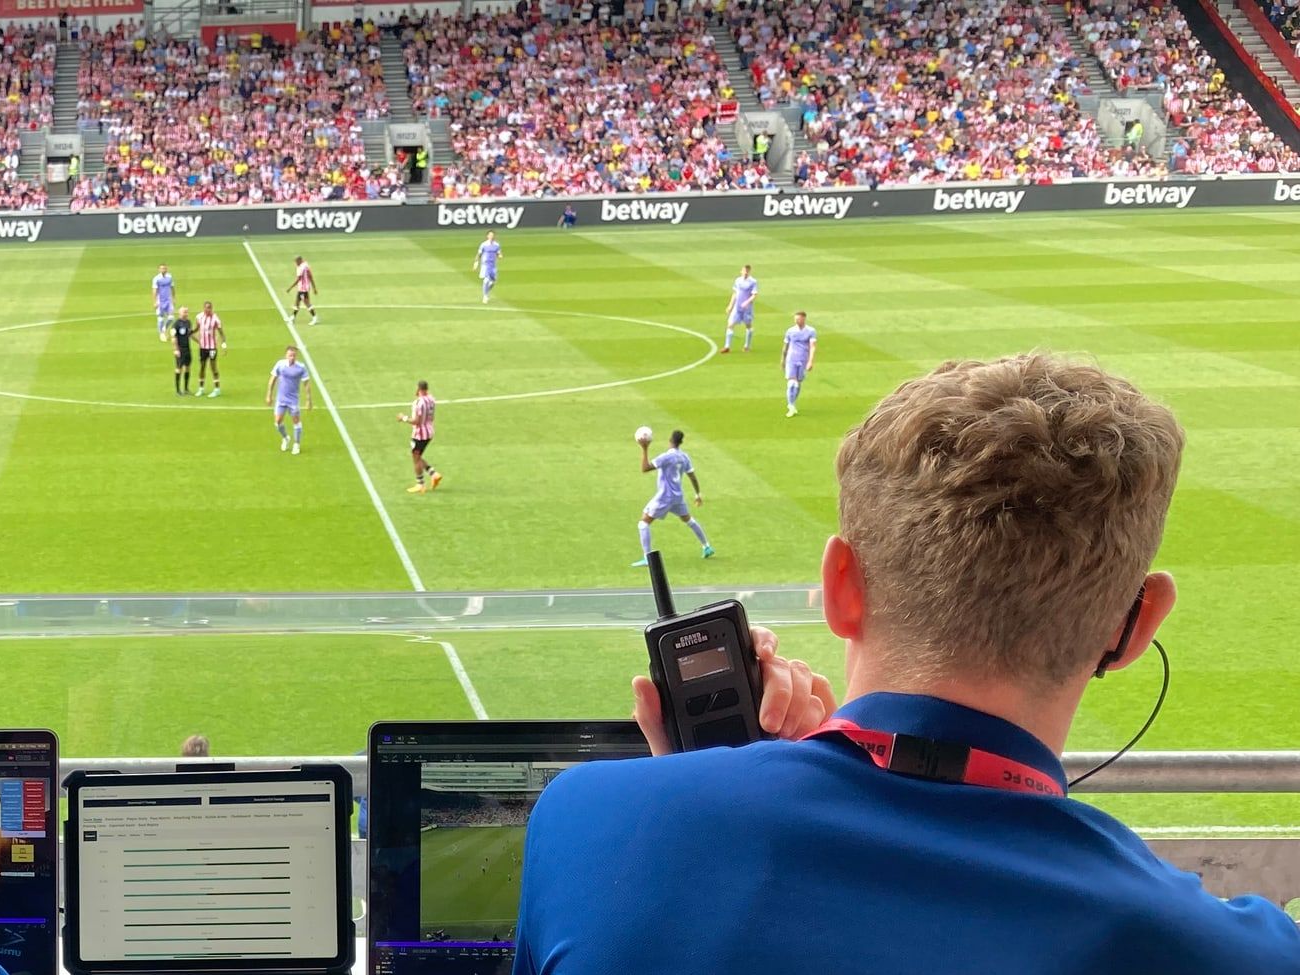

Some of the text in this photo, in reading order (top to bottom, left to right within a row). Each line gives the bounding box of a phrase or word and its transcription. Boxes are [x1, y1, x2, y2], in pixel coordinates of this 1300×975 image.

[763, 195, 853, 219] betway
[933, 189, 1025, 213] betway
[1104, 183, 1197, 208] betway
[276, 209, 362, 233] betway
[438, 205, 524, 228] betway
[601, 200, 689, 224] betway
[118, 213, 202, 237] betway
[675, 635, 708, 649] MULTICOM
[680, 632, 701, 642] GRAND
[1003, 771, 1021, 785] FC
